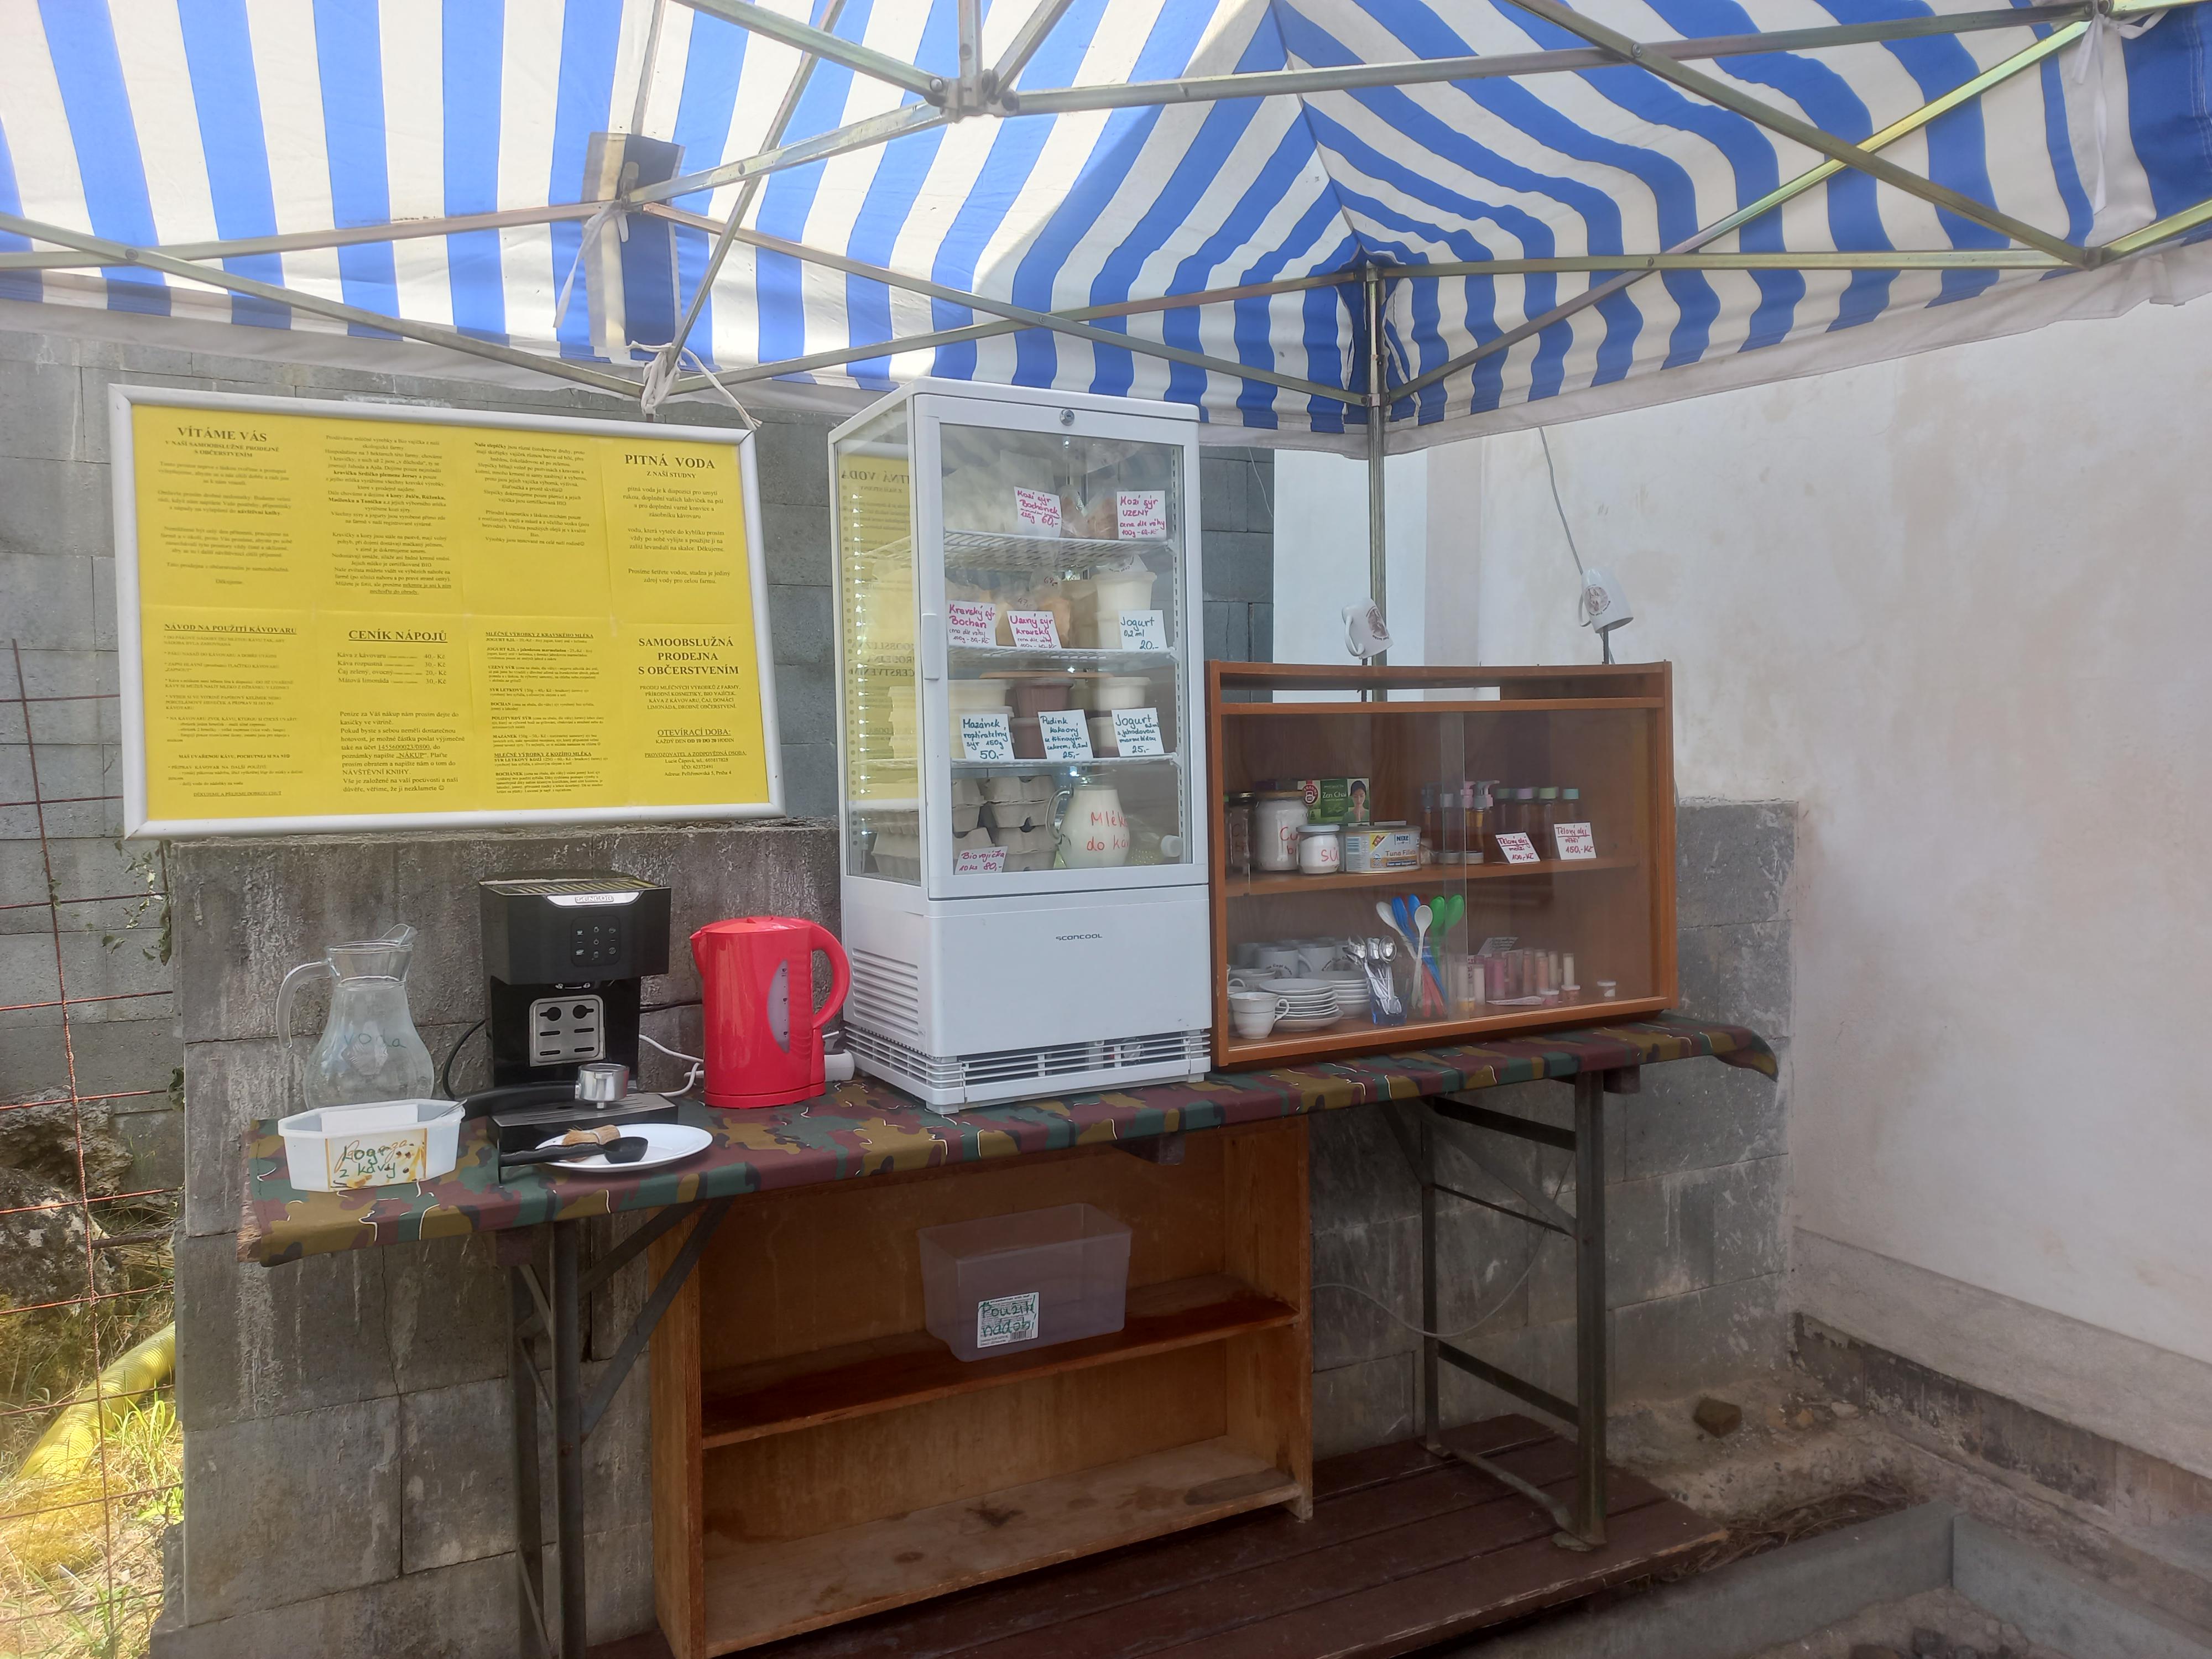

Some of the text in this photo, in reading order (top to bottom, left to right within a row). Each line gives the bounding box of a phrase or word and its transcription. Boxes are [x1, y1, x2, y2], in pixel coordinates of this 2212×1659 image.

[178, 426, 267, 442] VÍTÁME VÁS
[625, 454, 715, 468] PITNÁ VODA
[949, 615, 987, 628] Bochan
[1120, 617, 1155, 632] Jogurt
[212, 624, 247, 633] POUŽITÍ
[249, 625, 296, 634] KÁVOVARU
[349, 629, 447, 641] CENÍK NÁPOJŮ
[639, 637, 733, 646] SAMOOBSLUŽNÁ
[658, 652, 718, 660] PRODEJNA
[648, 664, 739, 674] OBČERSTVENÍM
[963, 718, 1000, 728] Mazánek
[1040, 716, 1068, 724] Pudink
[1115, 714, 1151, 729] Jogurt
[658, 727, 703, 736] OTEVÍRACÍ
[986, 740, 1004, 749] 150g
[980, 750, 1004, 759] 50,-
[1087, 836, 1104, 851] do
